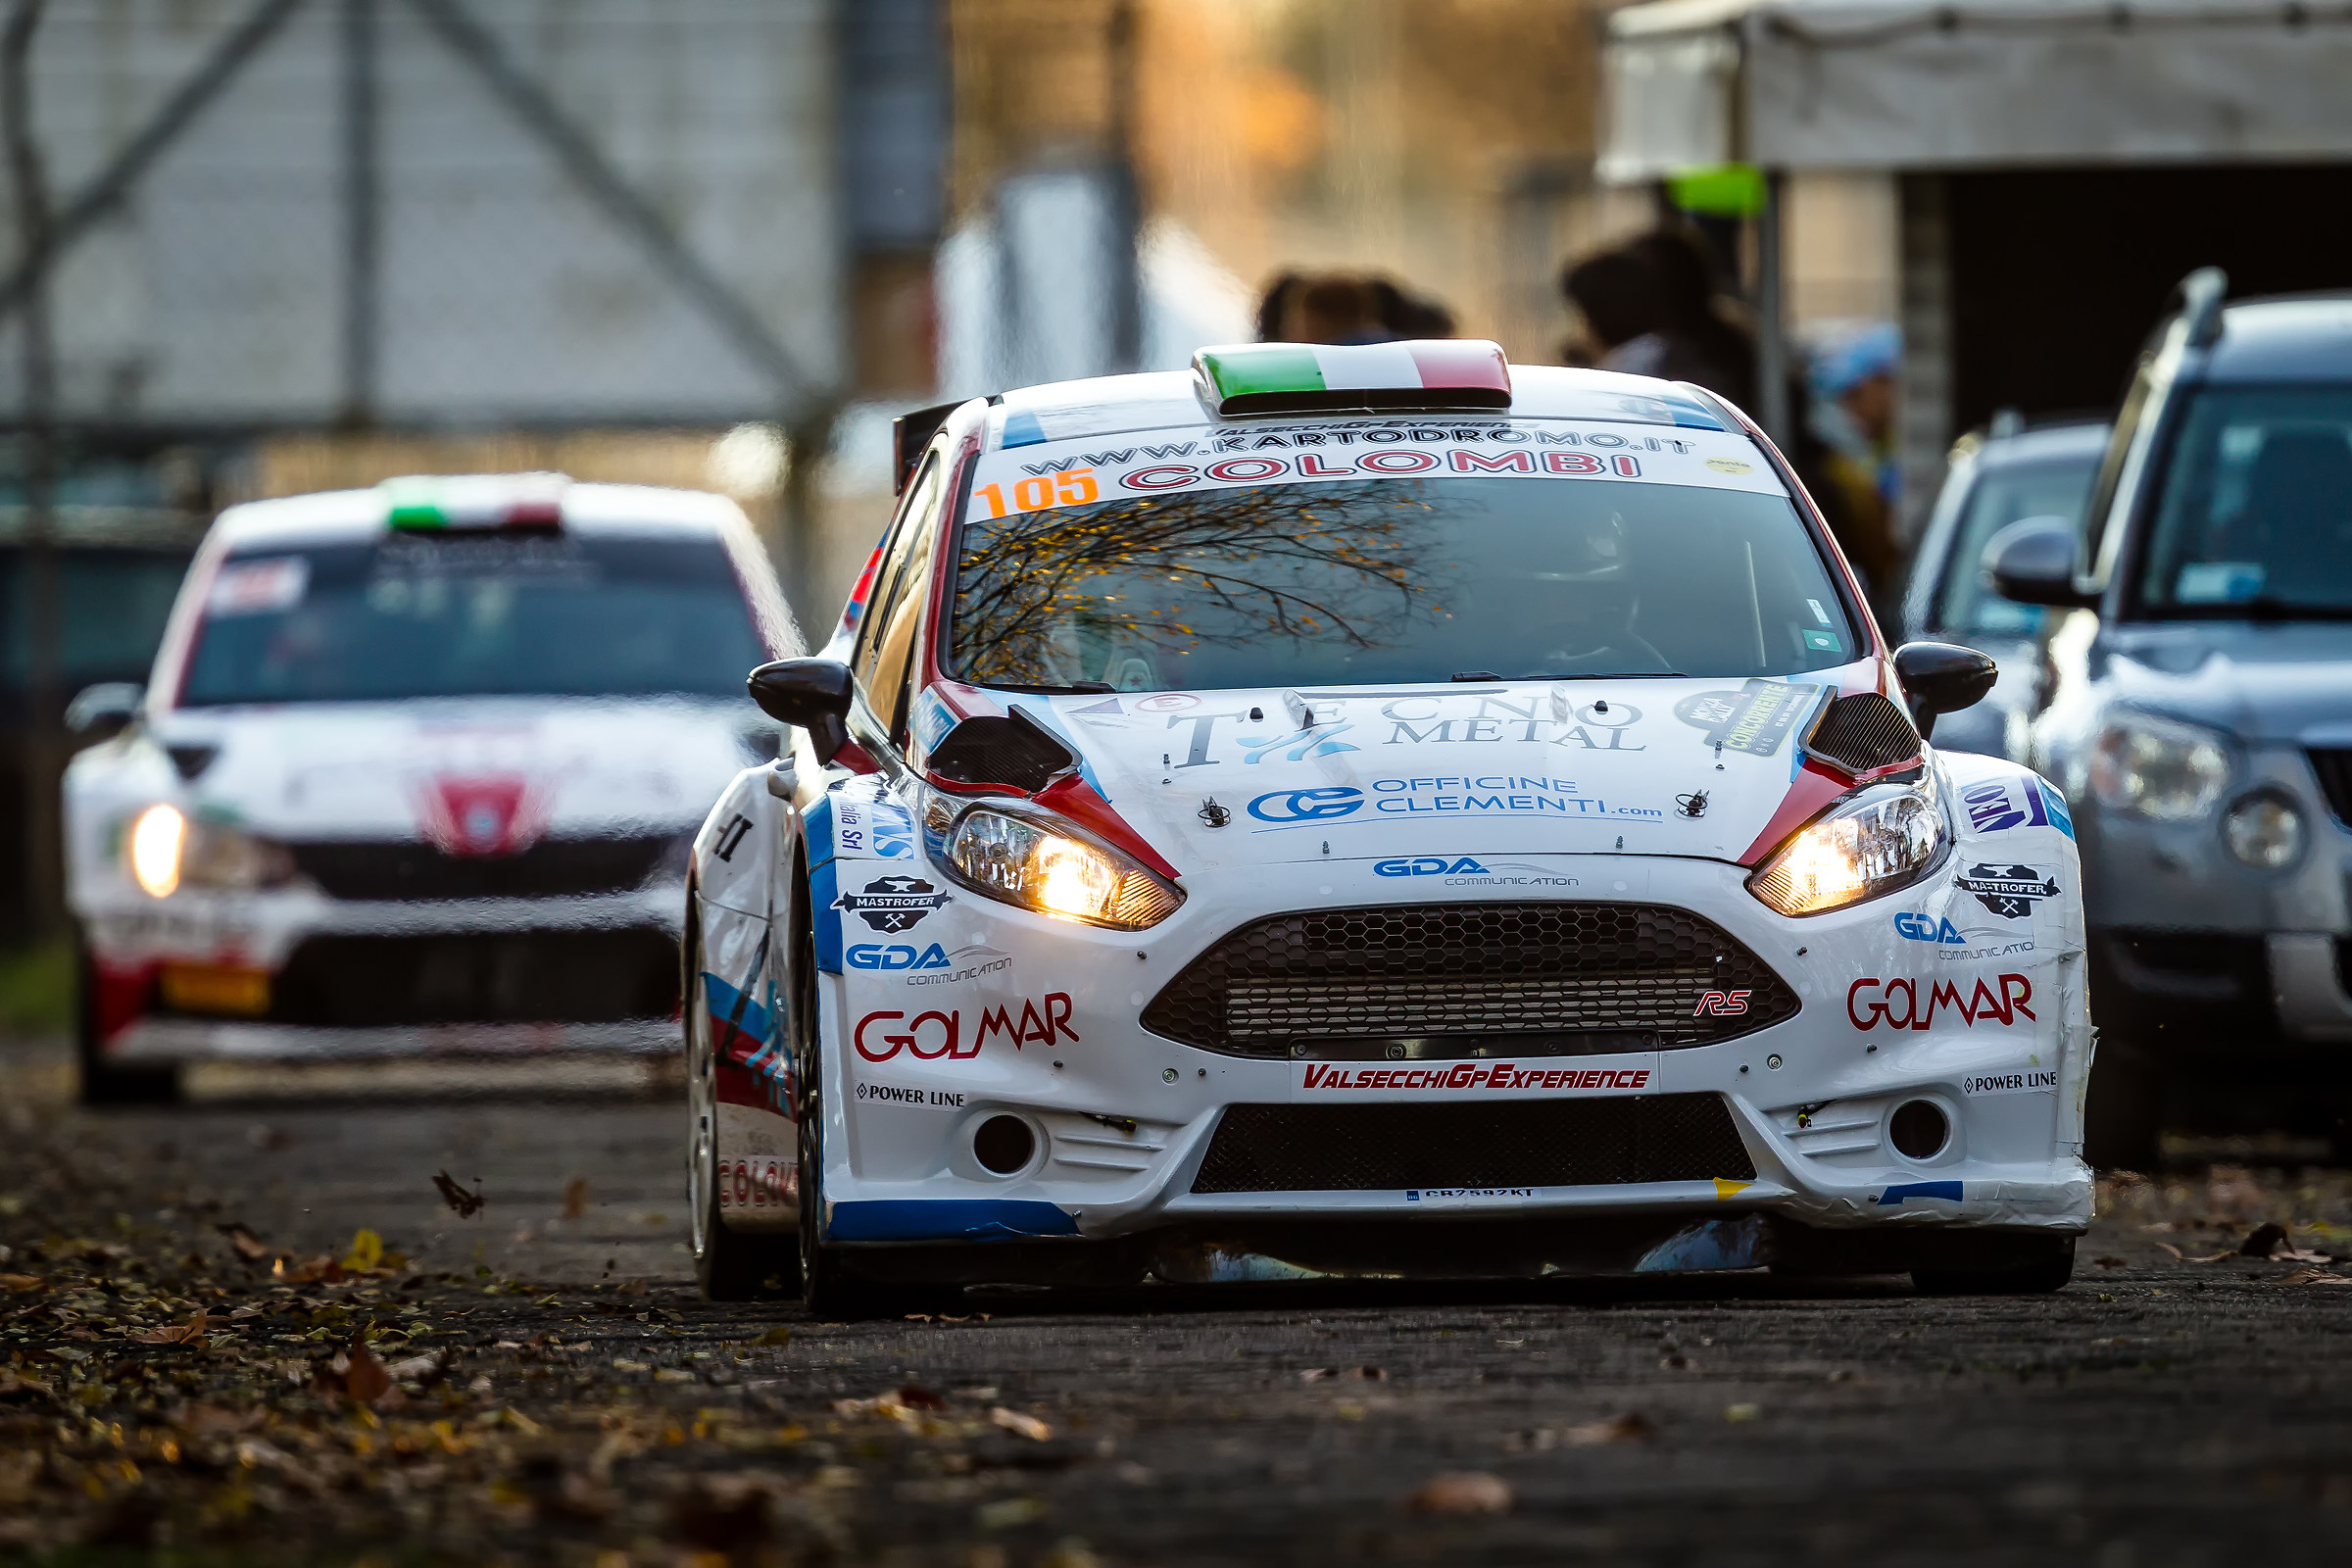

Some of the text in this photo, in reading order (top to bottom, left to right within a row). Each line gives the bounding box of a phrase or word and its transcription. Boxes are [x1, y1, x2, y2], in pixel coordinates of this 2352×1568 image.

[1020, 428, 1696, 476] WWW.KARTODROMO.IT
[1119, 449, 1642, 491] COLOMBI
[974, 466, 1100, 518] 105
[1725, 683, 1789, 749] CONCORRENTE
[1382, 718, 1647, 752] METAL
[1371, 776, 1579, 794] OFFICINE
[1373, 857, 1492, 877] GDA
[1445, 877, 1580, 887] COMMUNICATION
[856, 896, 935, 907] MASTROFER
[1894, 911, 1967, 944] GDA
[846, 943, 952, 970] GDA
[1938, 941, 2035, 960] COMMUNICATIO
[906, 956, 1012, 986] COMMUNICATION
[1846, 973, 2036, 1032] GOLMAR
[854, 992, 1080, 1063] GOLMAR
[1975, 1071, 2057, 1092] POWER LINE
[868, 1086, 965, 1108] POWER LINE
